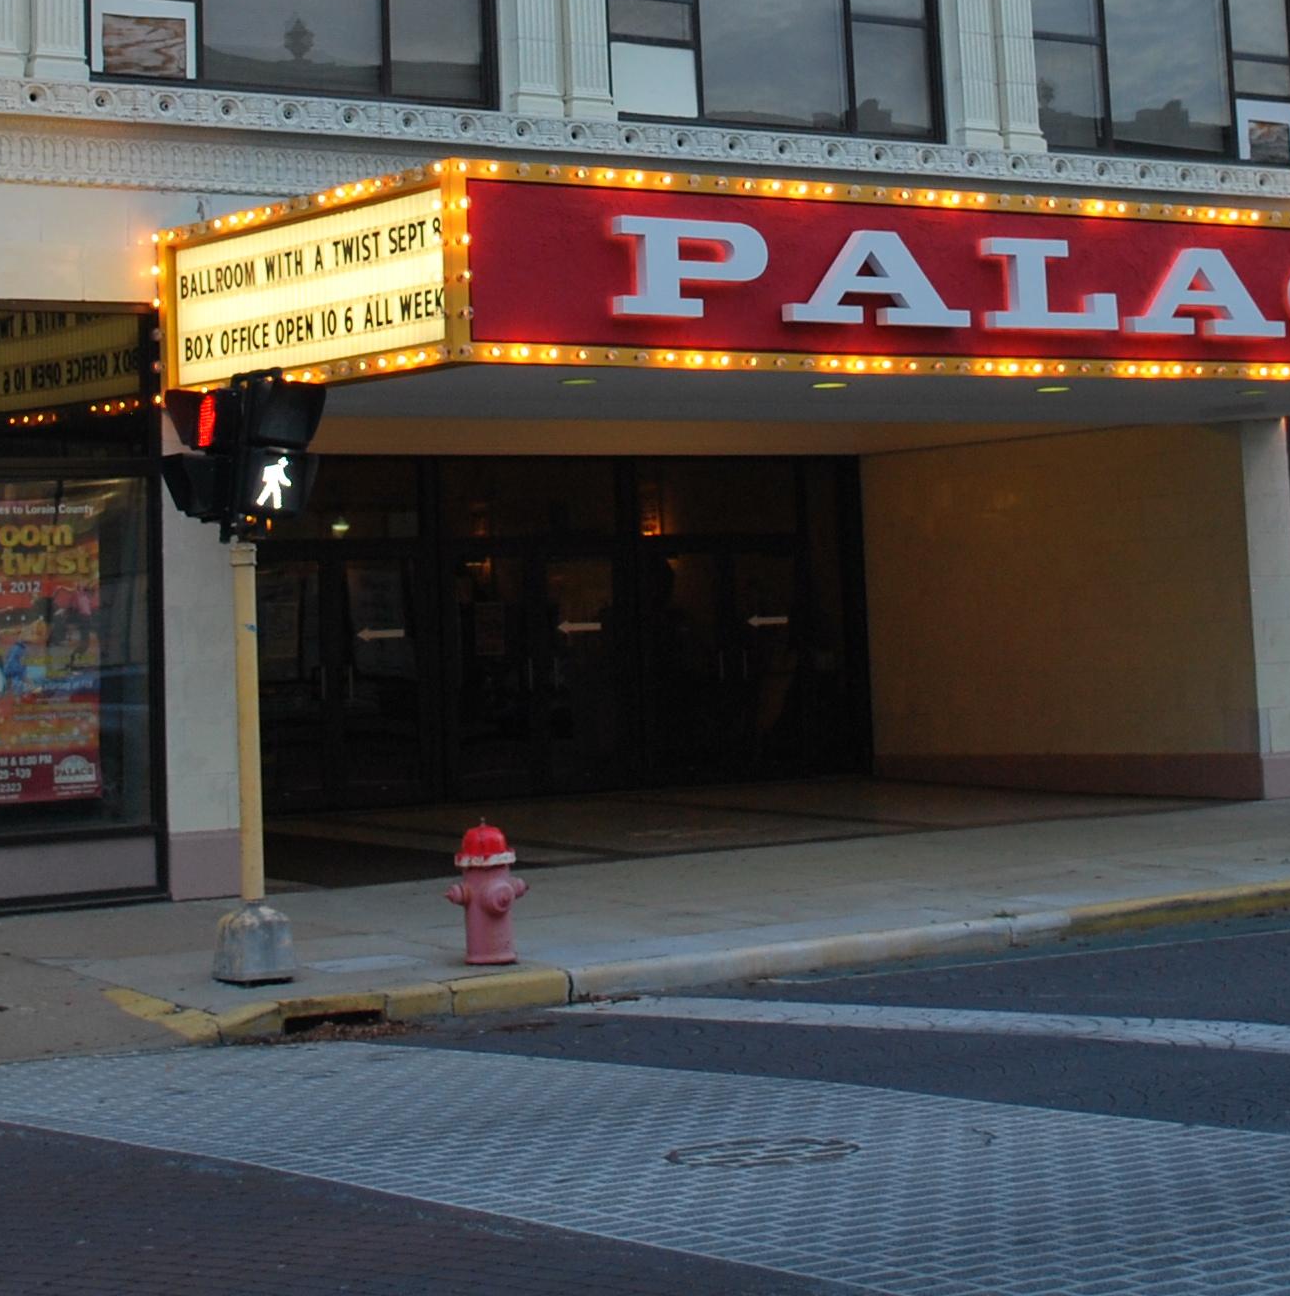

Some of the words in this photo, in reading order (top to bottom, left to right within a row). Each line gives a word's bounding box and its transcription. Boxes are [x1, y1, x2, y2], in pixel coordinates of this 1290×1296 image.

[180, 260, 256, 300] BALLROOM
[264, 249, 304, 282] WITH
[314, 244, 324, 272] A
[332, 230, 381, 267] TWIST
[388, 220, 426, 255] SEPT
[185, 333, 214, 362] BOX
[220, 322, 270, 356] OFFICE
[275, 312, 314, 345] OPEN
[321, 309, 337, 337] 10
[344, 306, 354, 334] 6
[364, 298, 393, 330] ALL
[399, 287, 445, 323] WEEK
[13, 505, 24, 514] to
[25, 504, 57, 515] Lorain
[58, 504, 94, 517] County
[2, 545, 90, 576] twist
[10, 581, 41, 594] 2012
